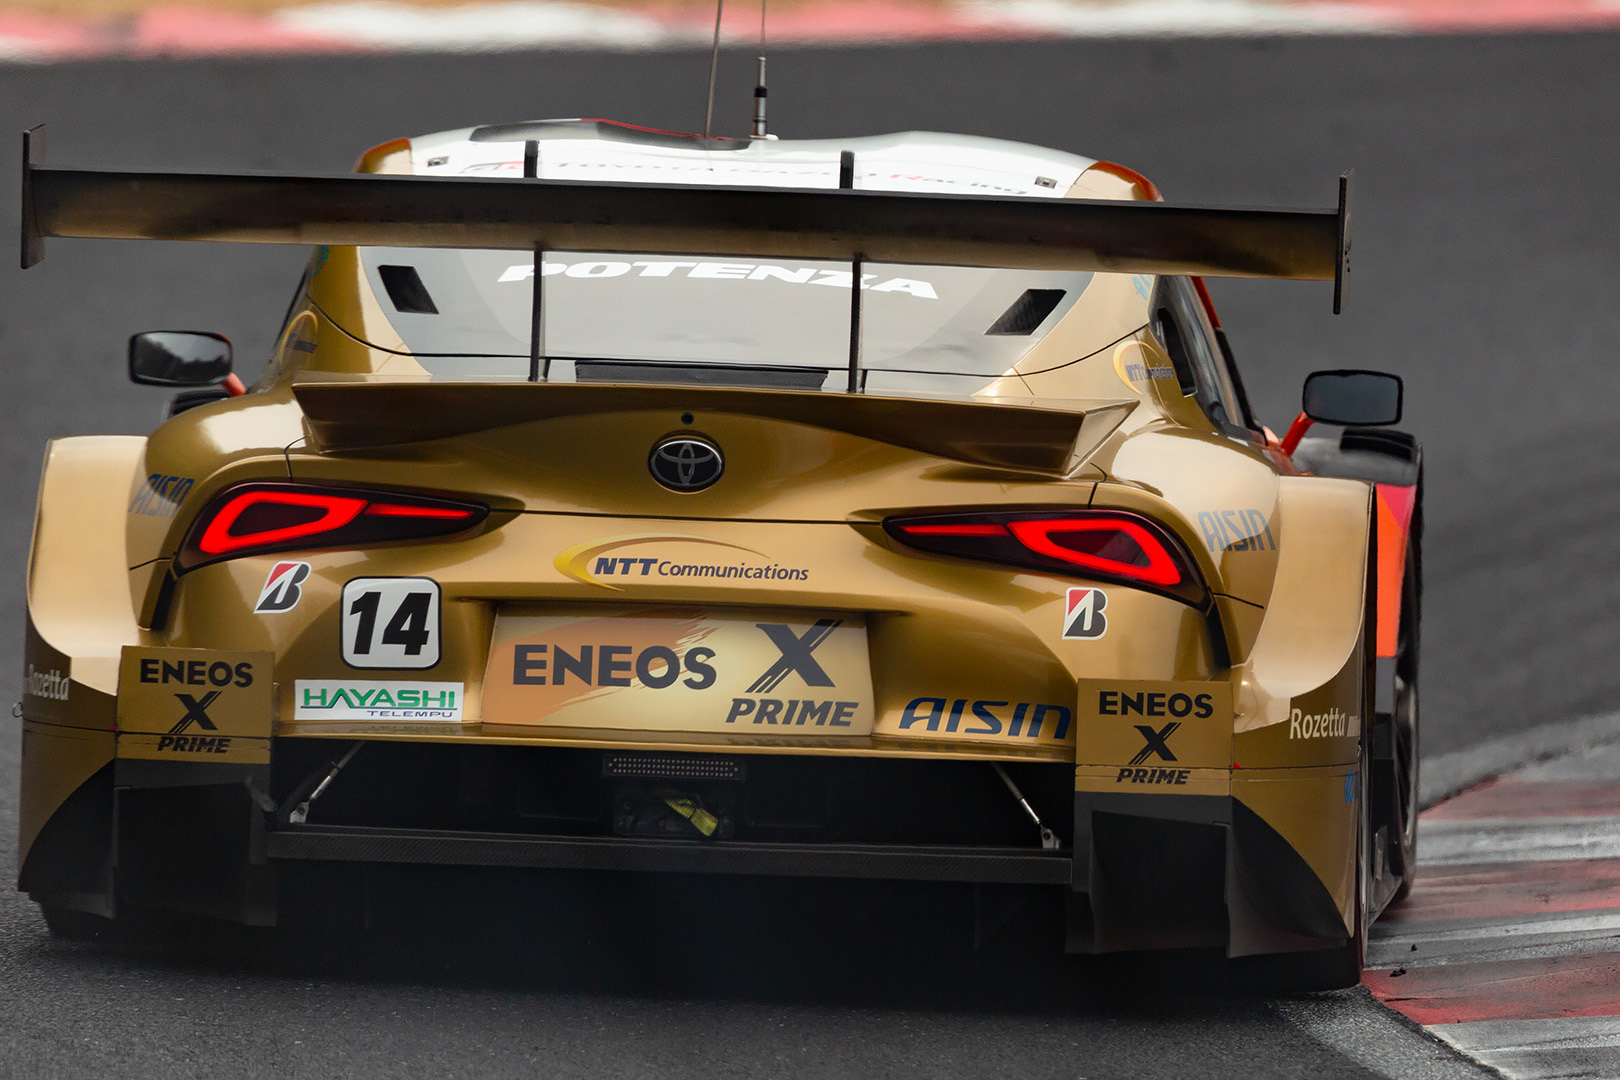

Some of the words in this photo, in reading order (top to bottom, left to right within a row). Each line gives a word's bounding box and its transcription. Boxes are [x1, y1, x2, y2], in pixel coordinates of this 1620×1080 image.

[498, 261, 939, 299] POTENZA
[1197, 509, 1276, 552] AISIN
[594, 557, 658, 575] NTT
[658, 561, 809, 580] Communications
[350, 591, 432, 655] 14
[140, 659, 253, 688] ENEOS
[512, 644, 717, 689] ENEOS
[304, 688, 455, 708] HAYASHI
[725, 698, 859, 727] PRIME
[1099, 691, 1213, 718] ENEOS
[367, 710, 453, 718] TELEMPU
[898, 697, 1071, 739] AISIN
[1290, 707, 1346, 739] Rozetta
[157, 736, 231, 754] PRIME
[1116, 767, 1191, 784] PRIME
